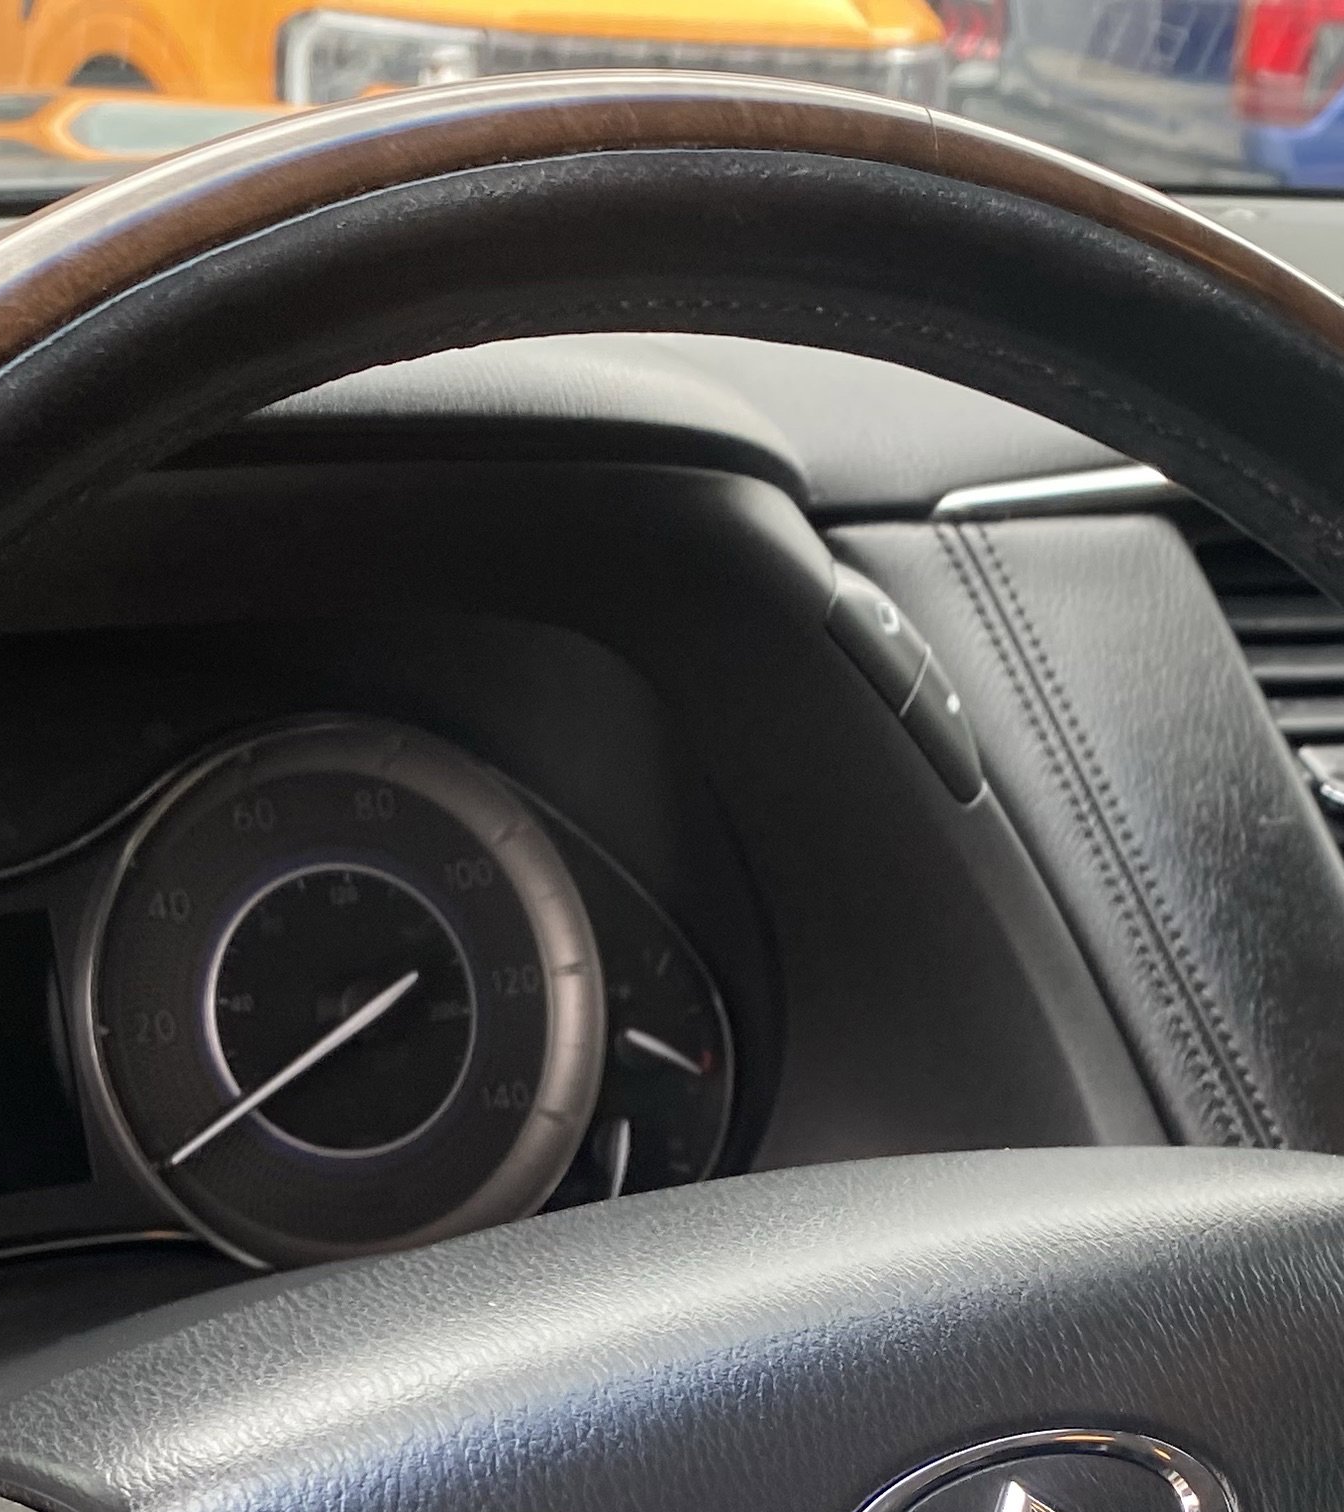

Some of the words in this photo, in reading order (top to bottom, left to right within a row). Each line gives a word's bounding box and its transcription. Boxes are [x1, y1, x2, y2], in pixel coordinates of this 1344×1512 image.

[232, 799, 277, 831] 60
[354, 788, 396, 821] 80
[443, 858, 494, 888] 100
[149, 888, 191, 921] 40
[492, 965, 539, 993] 120
[136, 1010, 176, 1042] 20
[483, 1080, 532, 1110] 140
